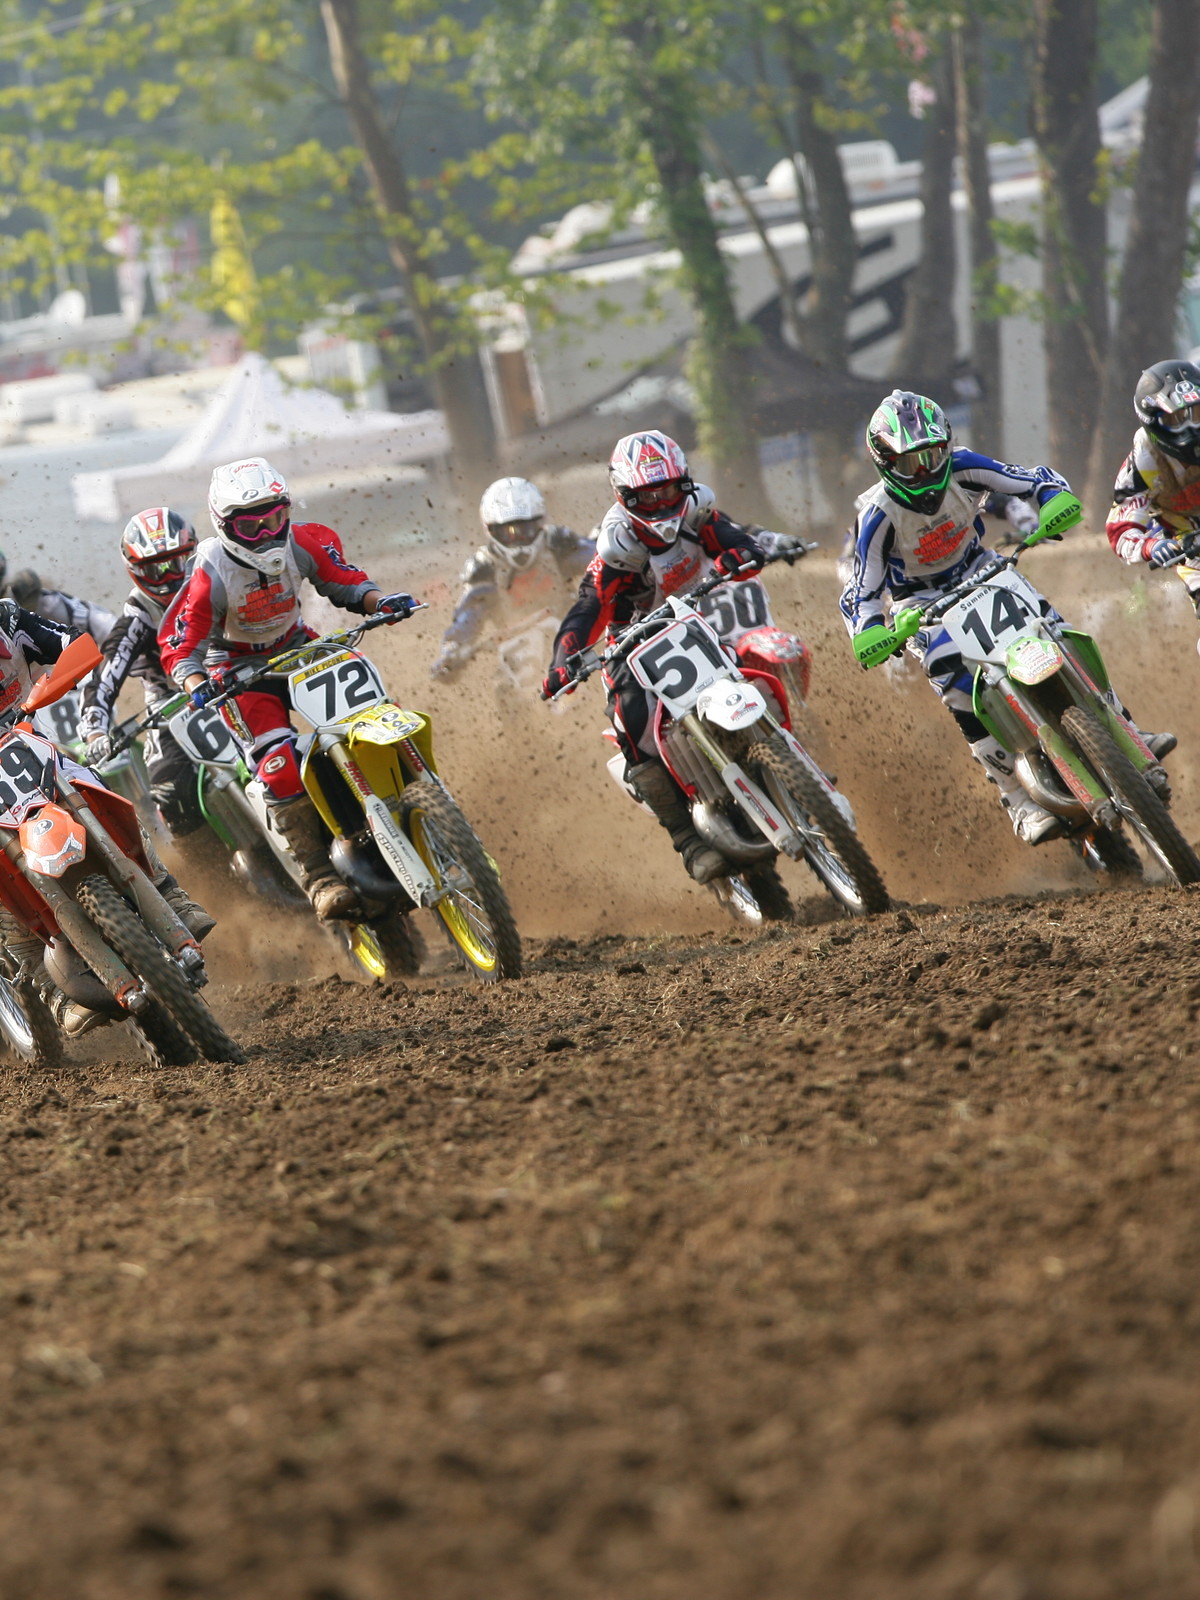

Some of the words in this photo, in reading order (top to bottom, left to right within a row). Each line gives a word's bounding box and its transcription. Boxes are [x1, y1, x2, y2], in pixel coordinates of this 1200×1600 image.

[1045, 504, 1080, 532] ACERBIS
[860, 635, 898, 660] ACERBIS
[961, 589, 1029, 656] 14
[638, 618, 728, 700] 51
[305, 660, 377, 722] 72
[187, 707, 231, 761] 6
